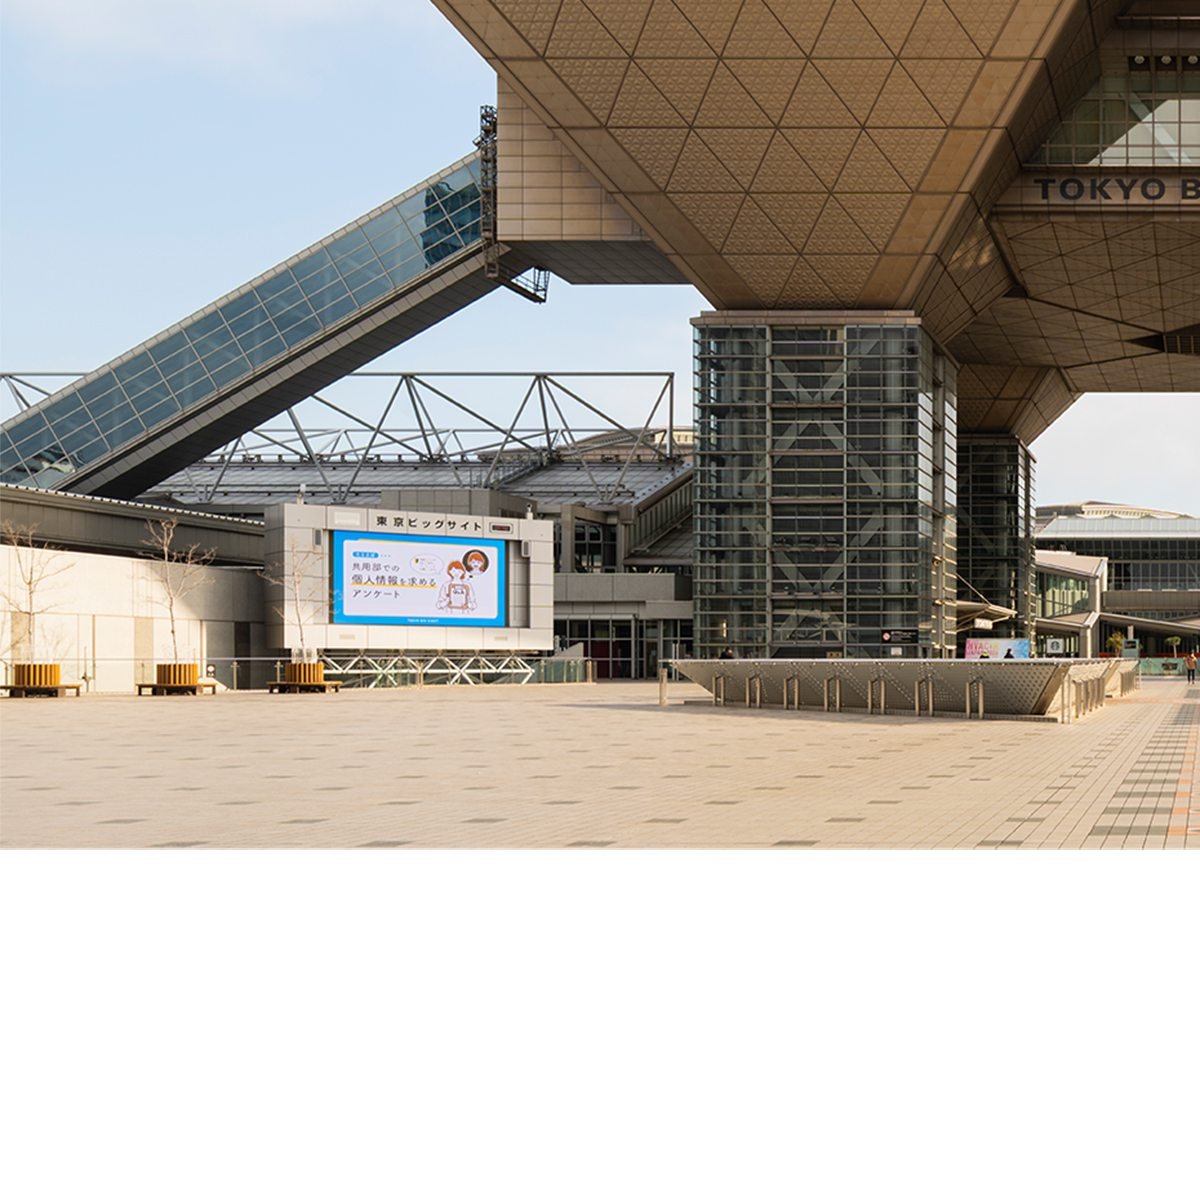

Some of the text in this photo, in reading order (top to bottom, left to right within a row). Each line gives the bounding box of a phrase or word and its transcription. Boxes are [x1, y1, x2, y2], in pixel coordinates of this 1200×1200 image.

[1034, 178, 1166, 200] TOKYO
[376, 515, 482, 531] 東京ビッグサイト
[352, 589, 400, 599] アンケート
